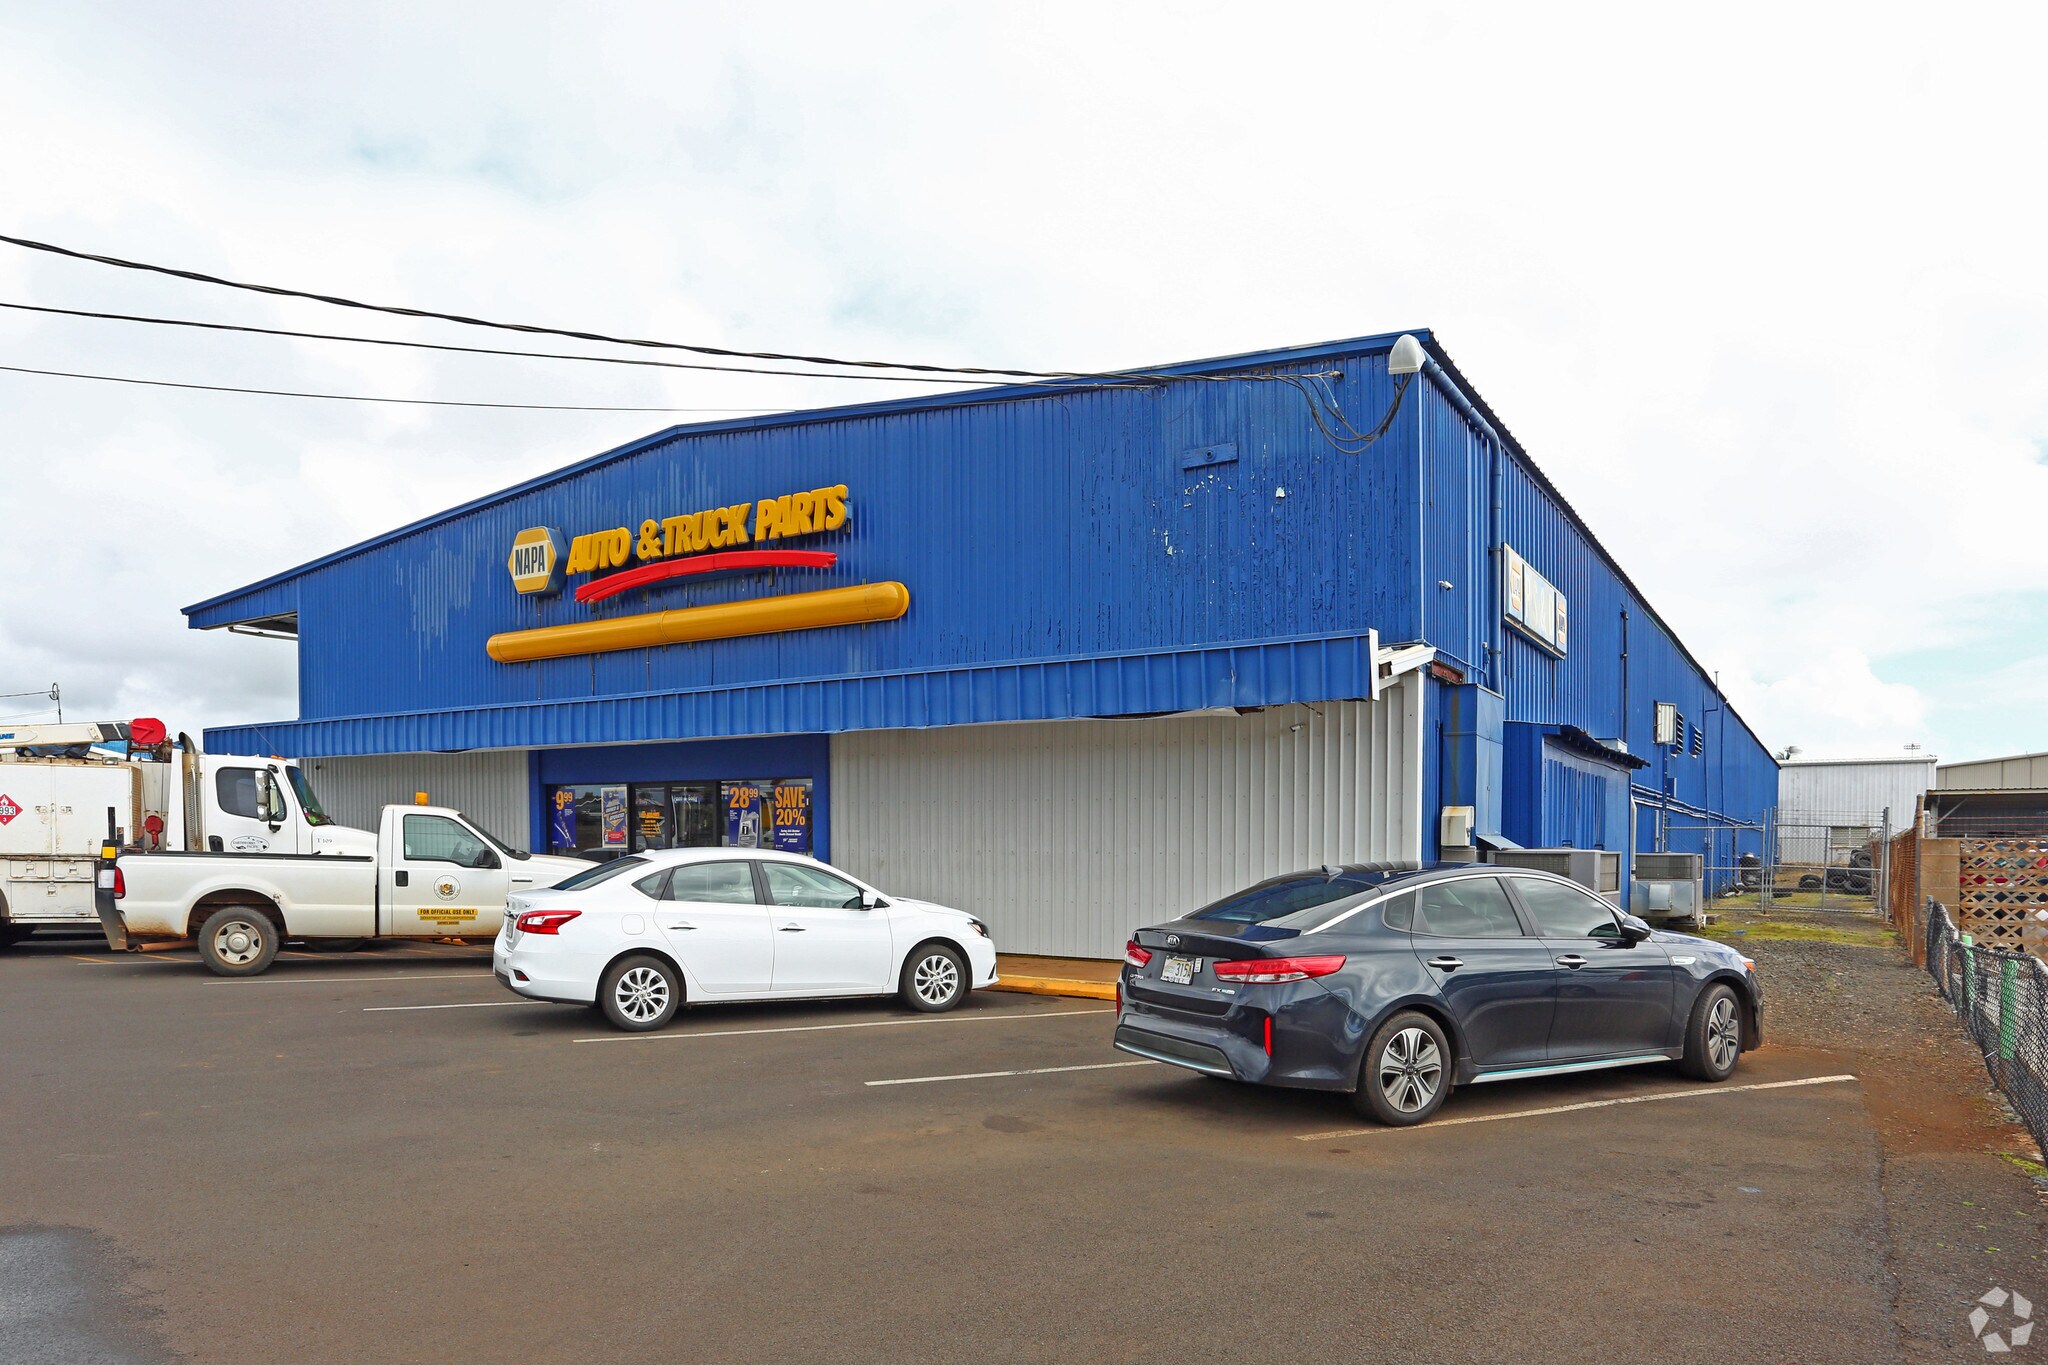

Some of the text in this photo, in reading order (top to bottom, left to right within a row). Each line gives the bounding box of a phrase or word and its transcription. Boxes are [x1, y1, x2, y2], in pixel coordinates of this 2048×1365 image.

[566, 483, 849, 576] AUTO & TRUCK PARTS
[514, 544, 547, 577] NAPA
[774, 786, 806, 808] SAVE
[0, 806, 15, 815] 993
[776, 809, 806, 826] 20%
[1167, 936, 1179, 945] KIA
